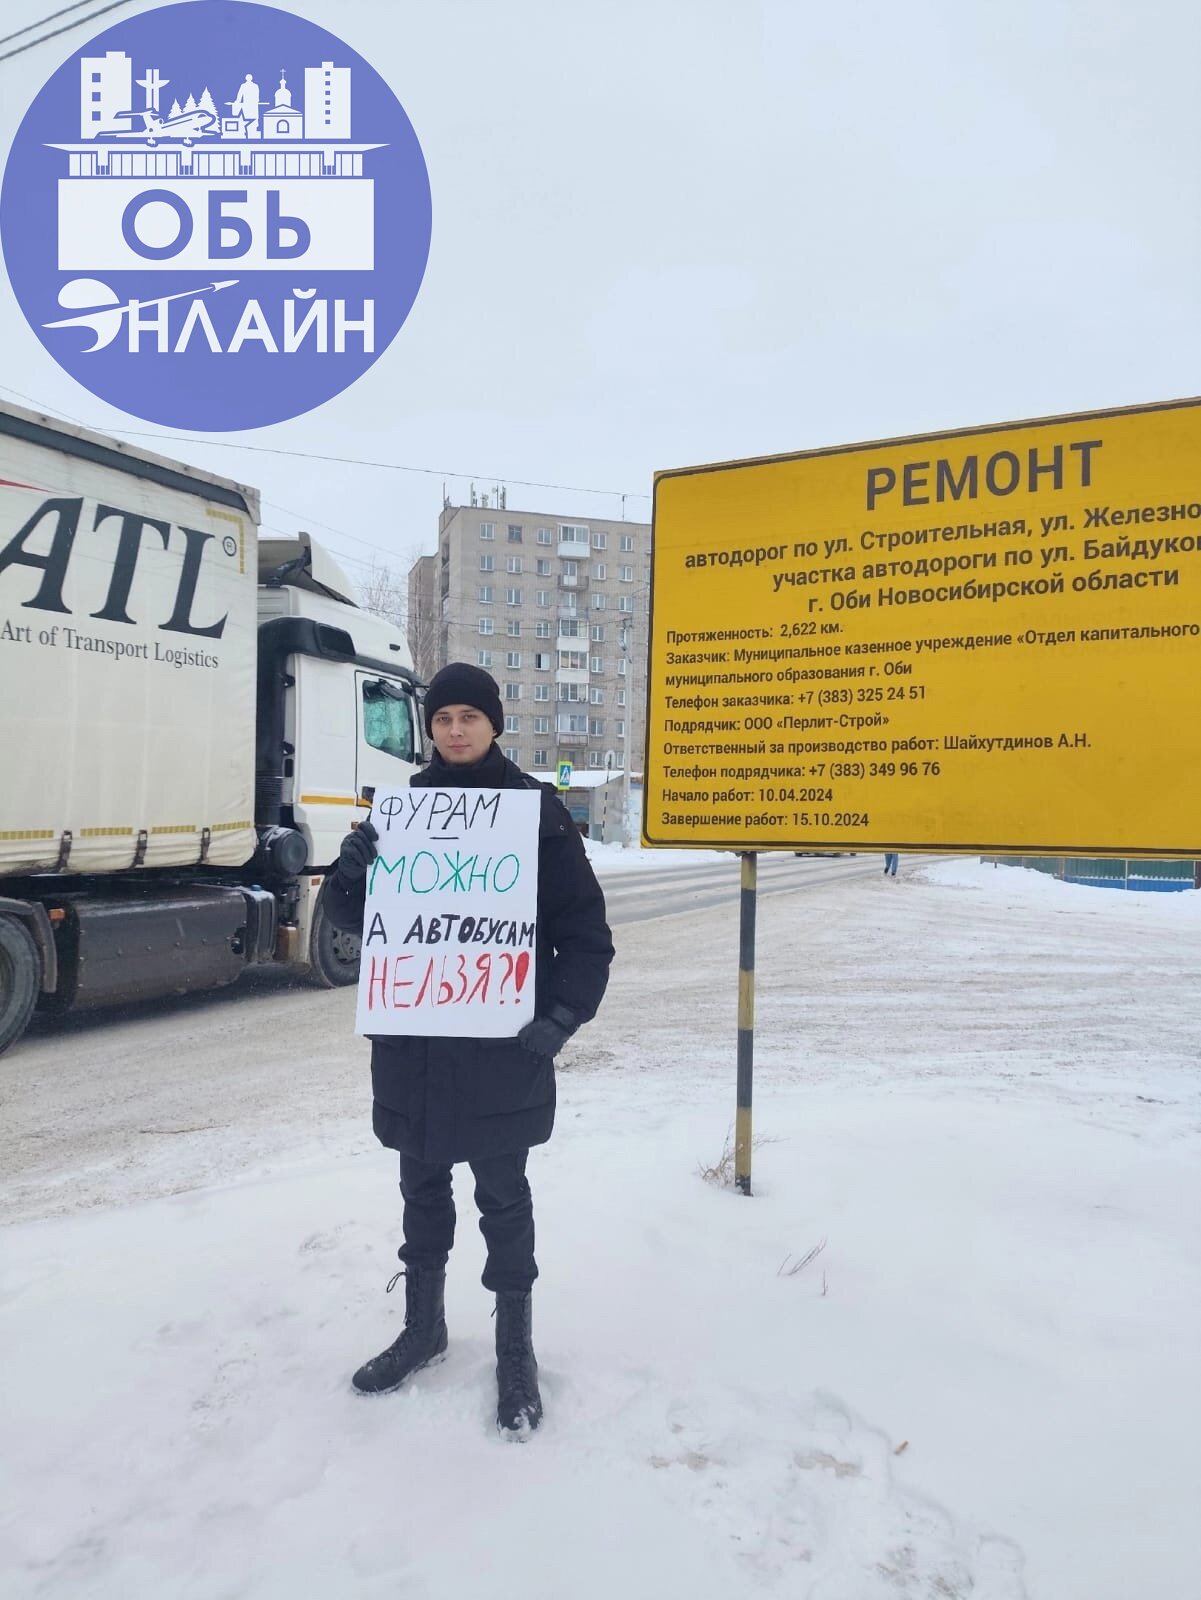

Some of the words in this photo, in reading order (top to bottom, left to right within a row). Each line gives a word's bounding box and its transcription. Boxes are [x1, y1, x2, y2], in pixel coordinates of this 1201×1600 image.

[866, 439, 1103, 511] РЕМОНТ
[684, 545, 788, 569] автодорог
[793, 542, 818, 558] по
[823, 538, 853, 560] ул.
[860, 519, 1033, 552] Строительная,
[1040, 515, 1075, 538] ул.
[1083, 503, 1201, 529] Железно
[0, 496, 229, 640] ATL
[772, 566, 856, 593] участка
[862, 552, 997, 580] автодороги
[1004, 549, 1033, 567] по
[1040, 546, 1075, 569] ул.
[808, 598, 823, 613] г.
[830, 589, 871, 611] Оби
[878, 572, 1064, 607] Новосибирской
[1071, 569, 1179, 592] области
[1, 619, 33, 643] Art
[39, 626, 58, 646] of
[63, 627, 148, 660] Transport
[155, 642, 219, 669] Logistics
[666, 627, 773, 647] Протяженность:
[780, 621, 817, 639] 2,622
[820, 623, 844, 634] км.
[666, 652, 730, 665] Заказчик:
[734, 645, 841, 665] Муниципальное
[844, 640, 912, 655] казенное
[915, 634, 1012, 654] учреждение
[1016, 629, 1076, 646] «Отдел
[1080, 623, 1201, 642] капитального
[665, 671, 774, 689] муниципального
[776, 666, 865, 684] образования
[869, 666, 880, 677] г.
[883, 660, 912, 676] Оби
[664, 694, 719, 712] Телефон
[722, 694, 794, 708] заказчика:
[798, 691, 814, 705] +7
[817, 688, 854, 707] (383)
[857, 687, 884, 702] 325
[886, 686, 906, 701] 24
[909, 685, 925, 700] 51
[664, 719, 741, 735] Подрядчик:
[744, 716, 773, 730] ООО
[776, 711, 890, 732] «Перлит-Строй»
[663, 740, 766, 755] Ответственный
[769, 743, 785, 754] за
[788, 740, 888, 757] производство
[891, 735, 939, 755] работ:
[943, 734, 1054, 753] Шайхутдинов
[1057, 733, 1092, 748] А.Н.
[662, 764, 717, 781] Телефон
[720, 766, 806, 781] подрядчика:
[808, 763, 826, 777] +7
[829, 762, 865, 780] (383)
[869, 762, 896, 777] 349
[899, 761, 918, 777] 96
[921, 761, 941, 776] 76
[379, 791, 501, 830] ФУРАМ
[662, 788, 710, 802] Начало
[712, 788, 755, 805] работ:
[759, 788, 833, 802] 10.04.2024
[661, 811, 742, 829] Завершение
[744, 811, 788, 829] работ:
[792, 812, 870, 827] 15.10.2024
[369, 850, 520, 896] МОЖНО
[366, 912, 388, 946] А
[403, 914, 535, 948] АВТОБУСАМ
[368, 950, 530, 1010] НЕЛЬЗЯ?!
